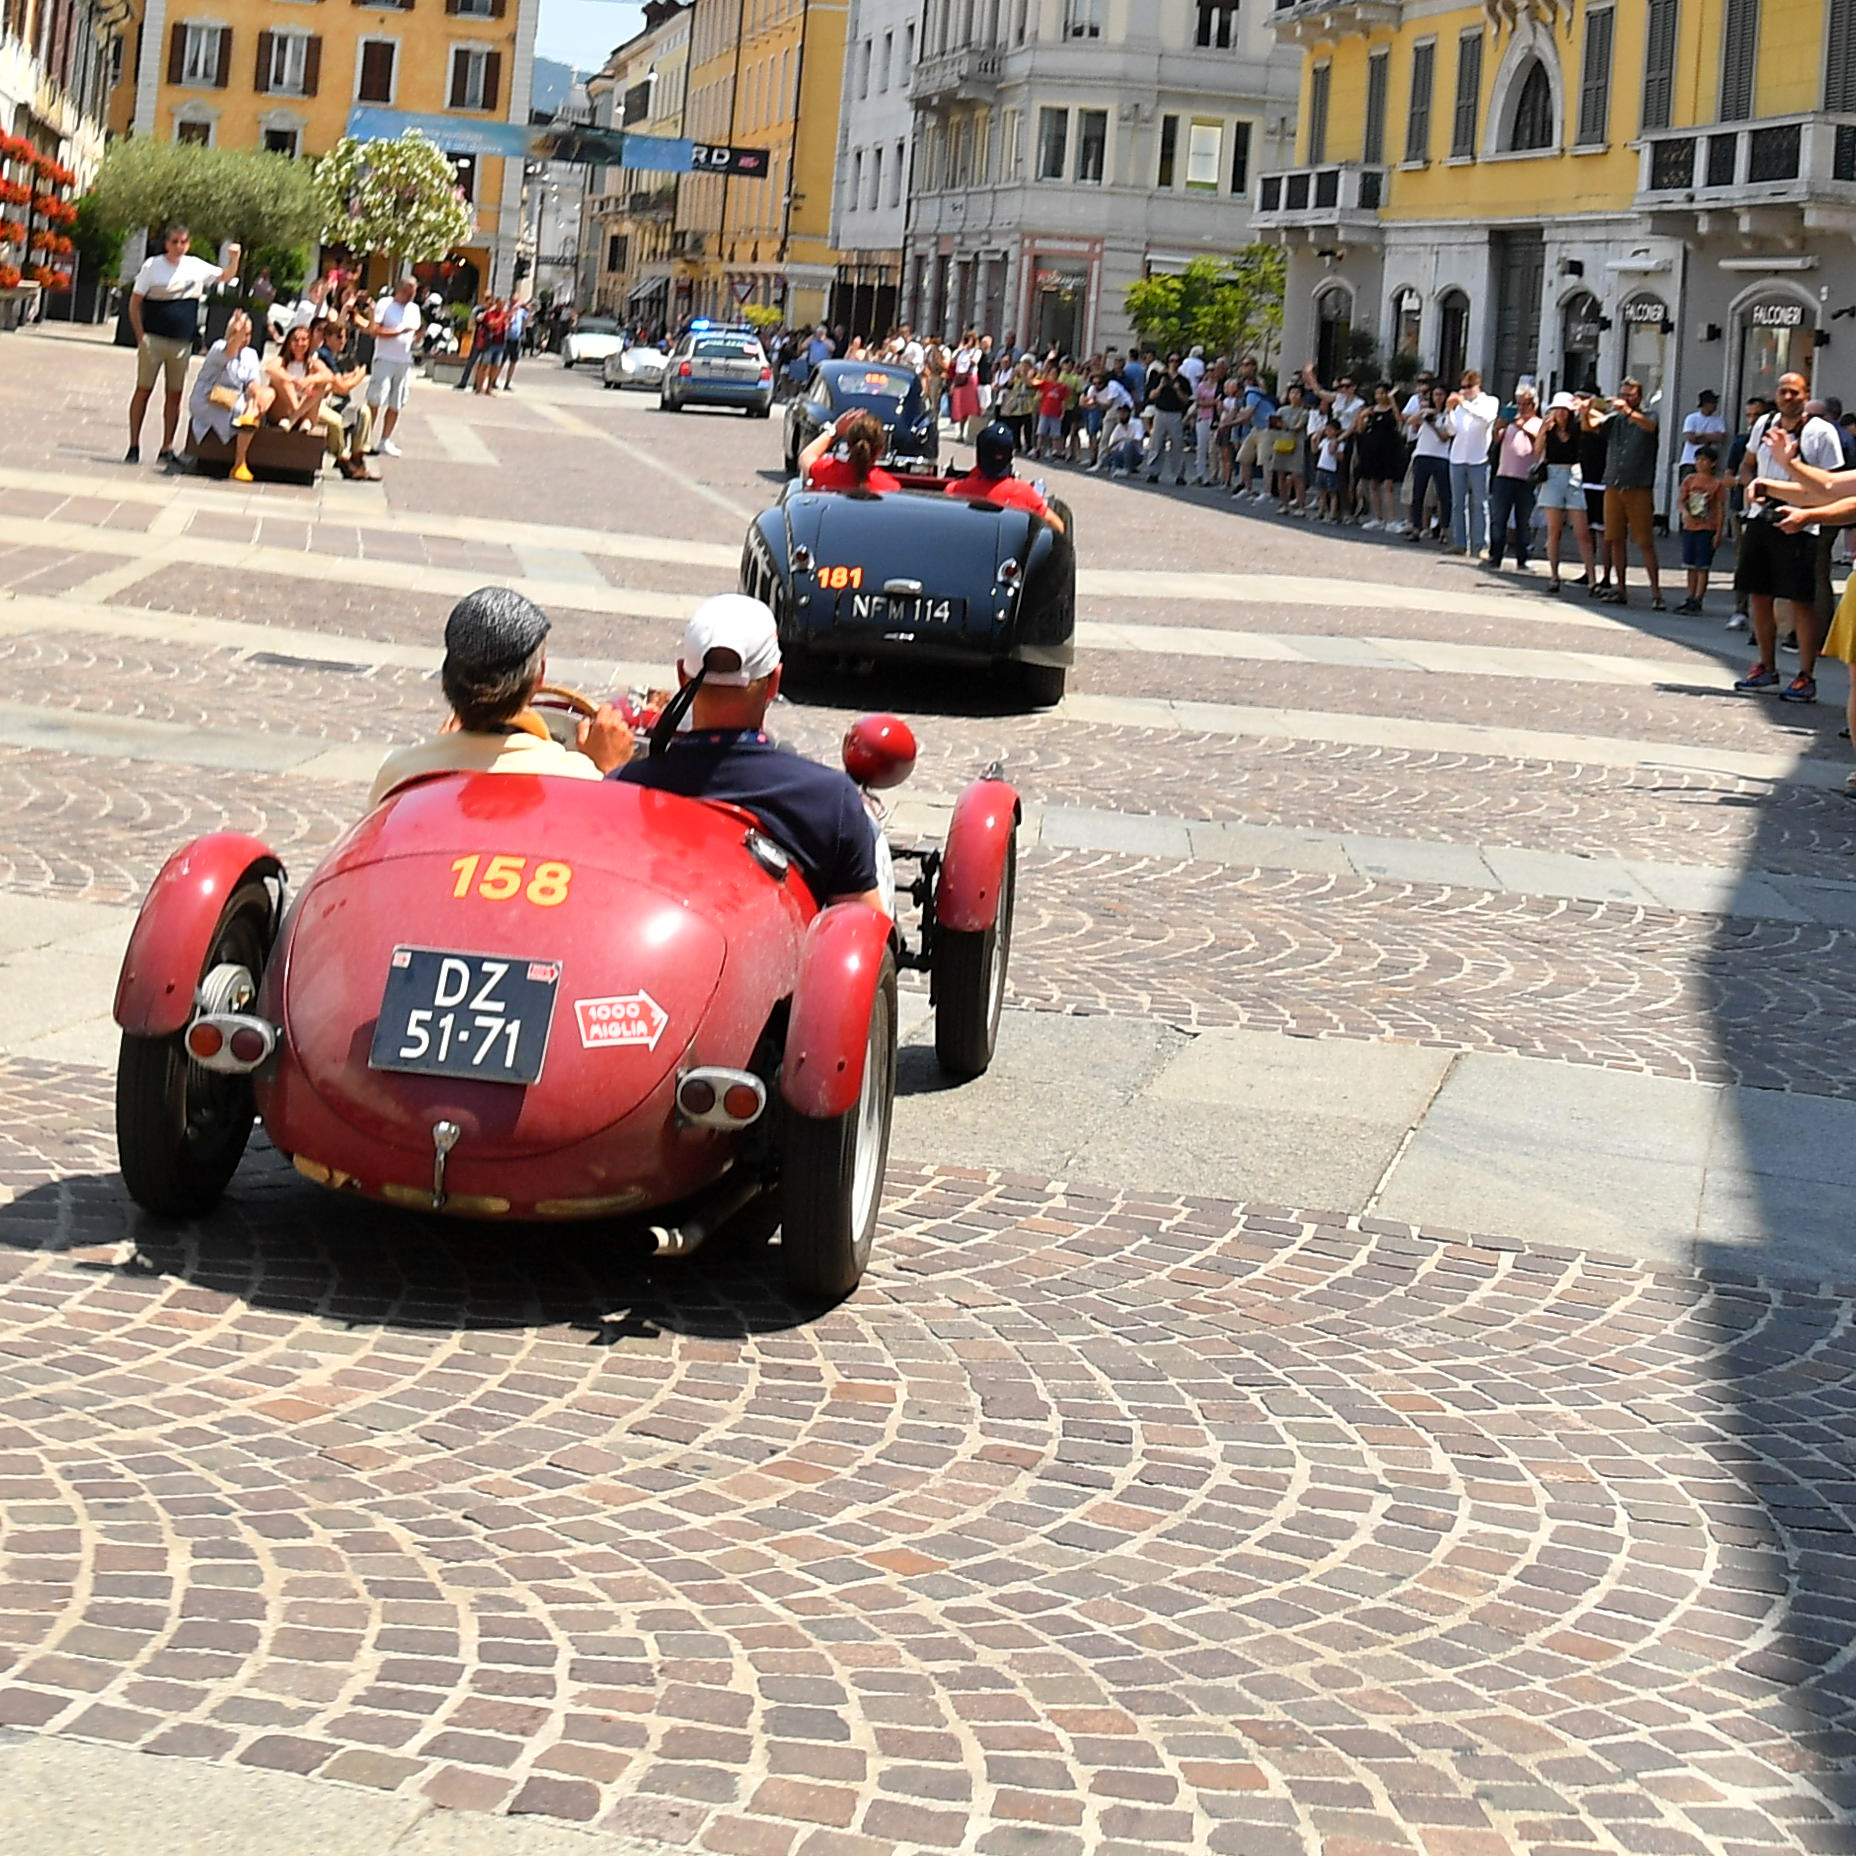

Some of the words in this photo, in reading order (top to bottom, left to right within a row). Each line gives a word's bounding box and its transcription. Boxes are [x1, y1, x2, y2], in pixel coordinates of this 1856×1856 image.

[1752, 303, 1802, 325] FALCONERI
[817, 565, 863, 591] 181
[852, 594, 905, 621] NFM
[914, 598, 950, 624] 114
[450, 853, 573, 907] 158
[434, 958, 509, 1012] DZ
[587, 1002, 641, 1020] 1000
[589, 1019, 649, 1040] MIGLIA
